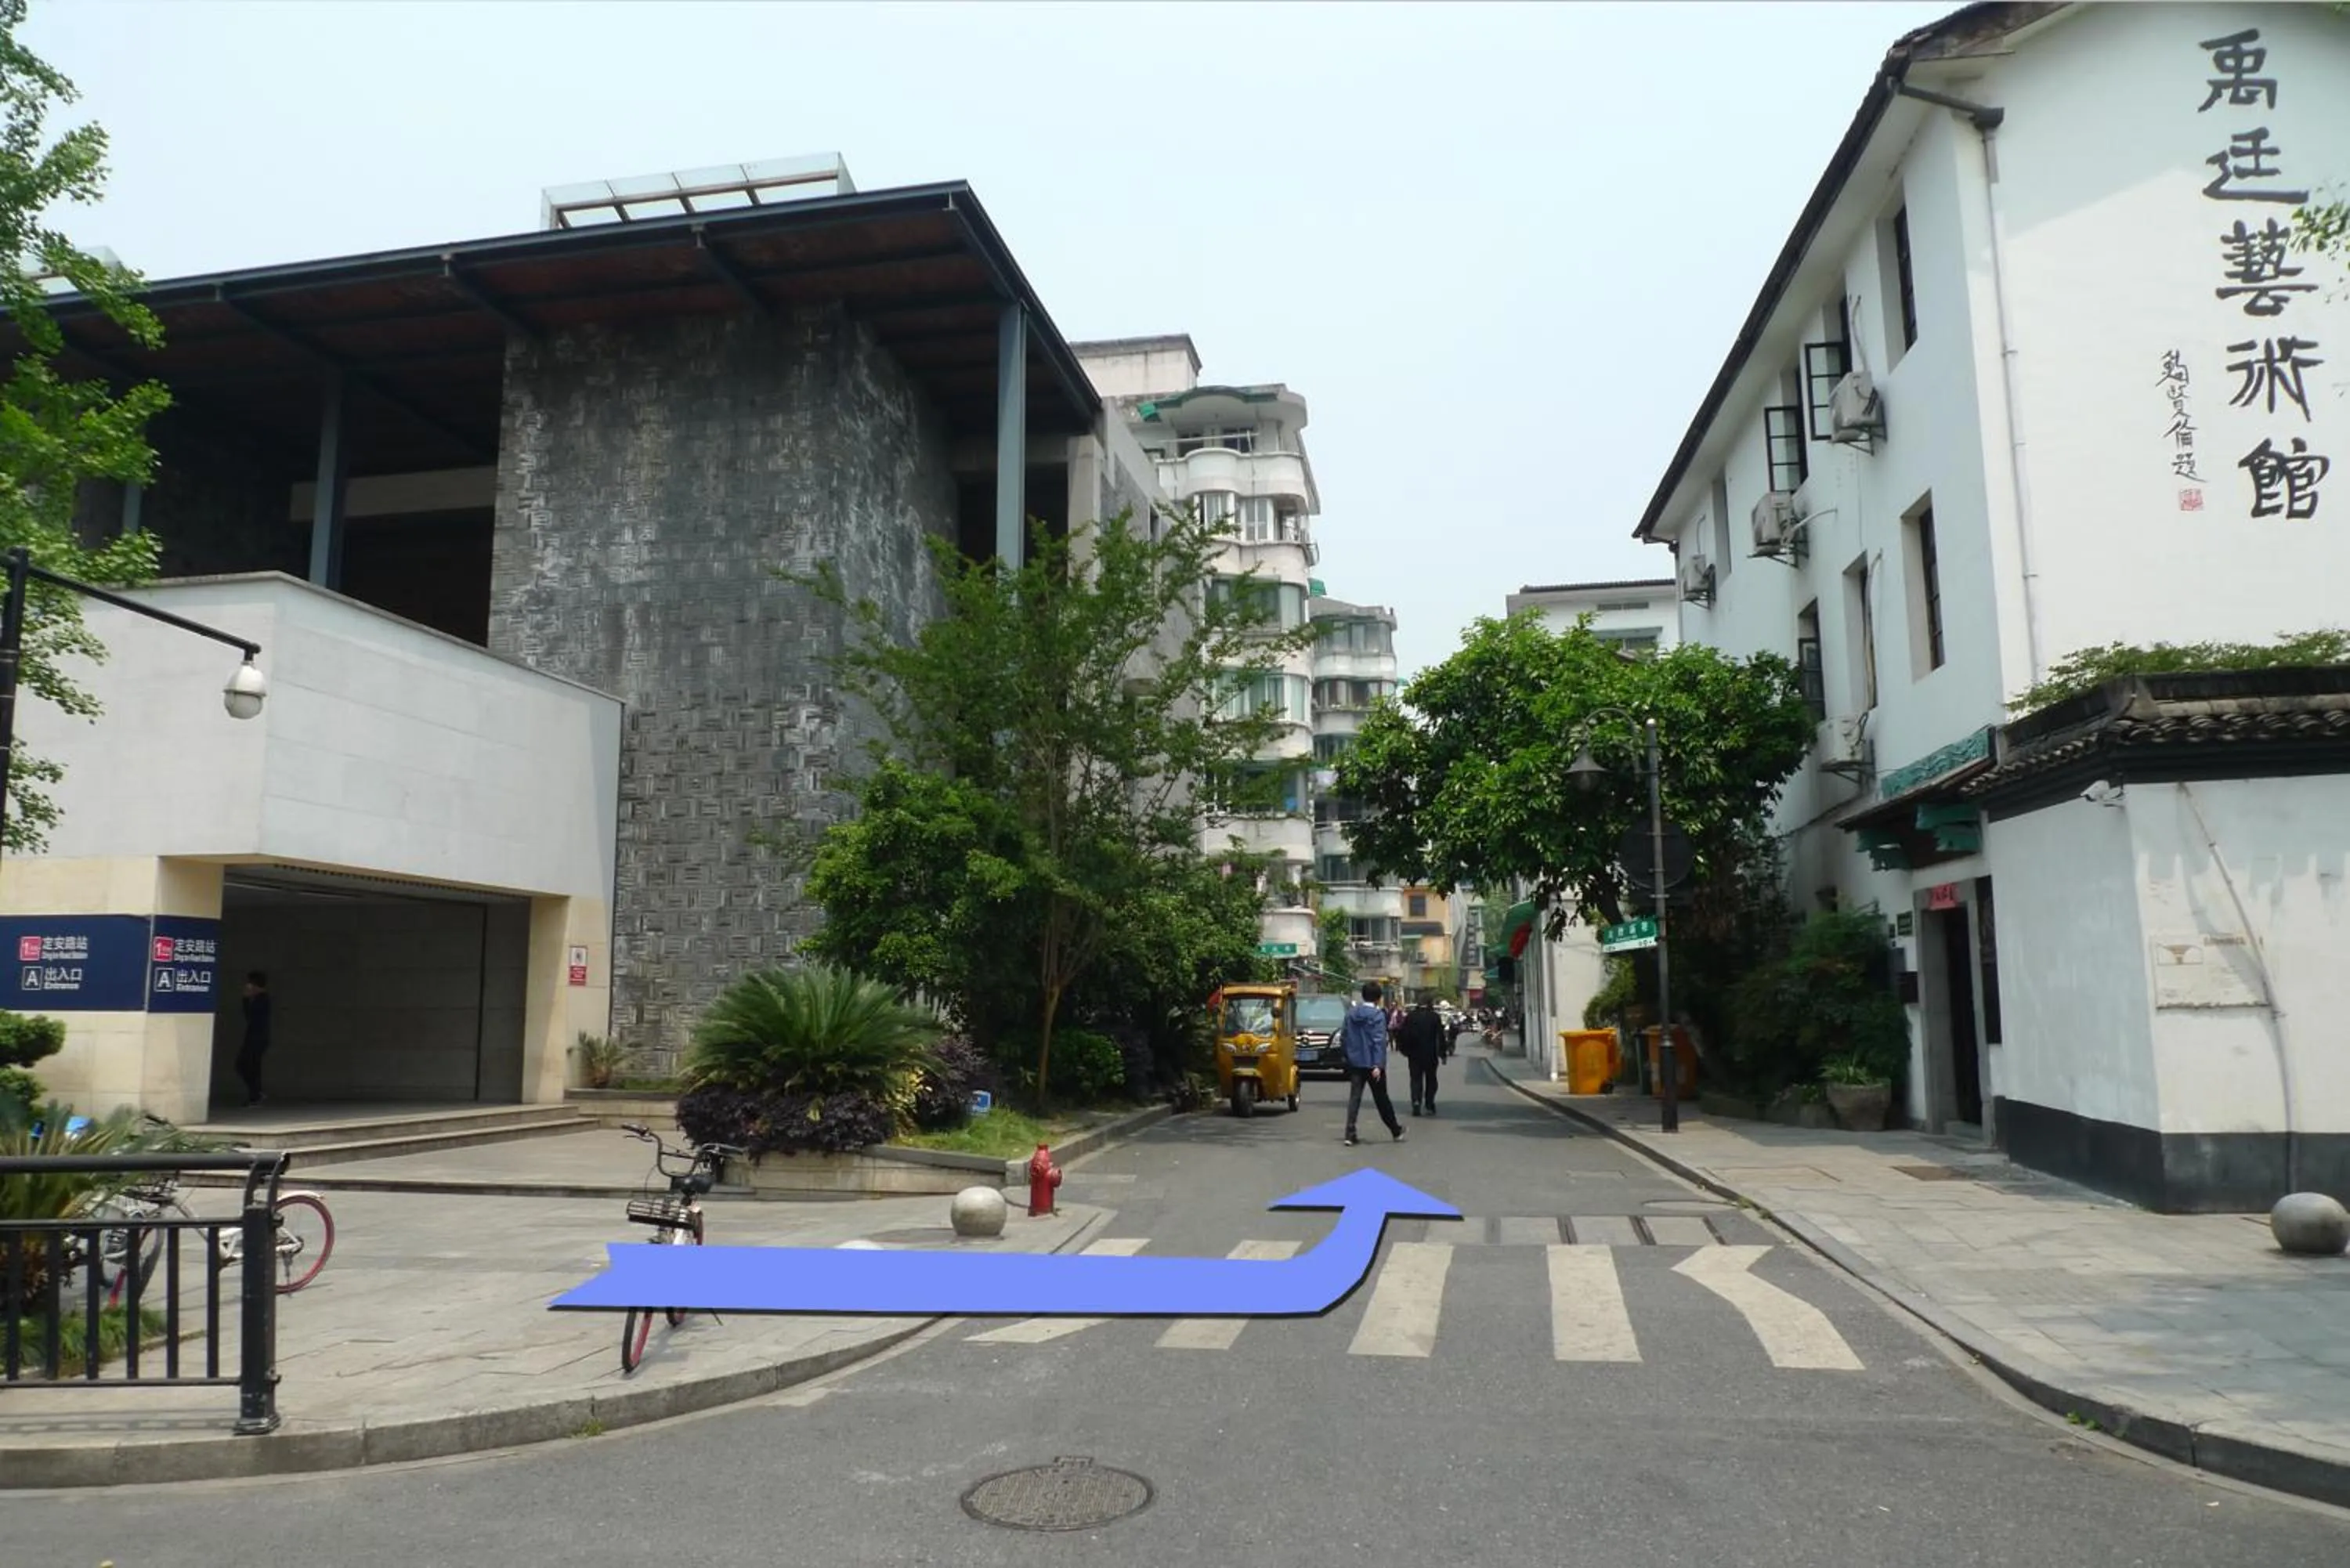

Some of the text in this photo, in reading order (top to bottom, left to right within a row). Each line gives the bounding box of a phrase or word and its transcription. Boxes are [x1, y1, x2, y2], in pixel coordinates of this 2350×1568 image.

[43, 935, 88, 950] 定安路站
[174, 939, 216, 953] 定安路站
[25, 970, 38, 986] A
[45, 967, 82, 981] 出入口
[157, 971, 171, 988] A
[176, 970, 211, 983] 出入口
